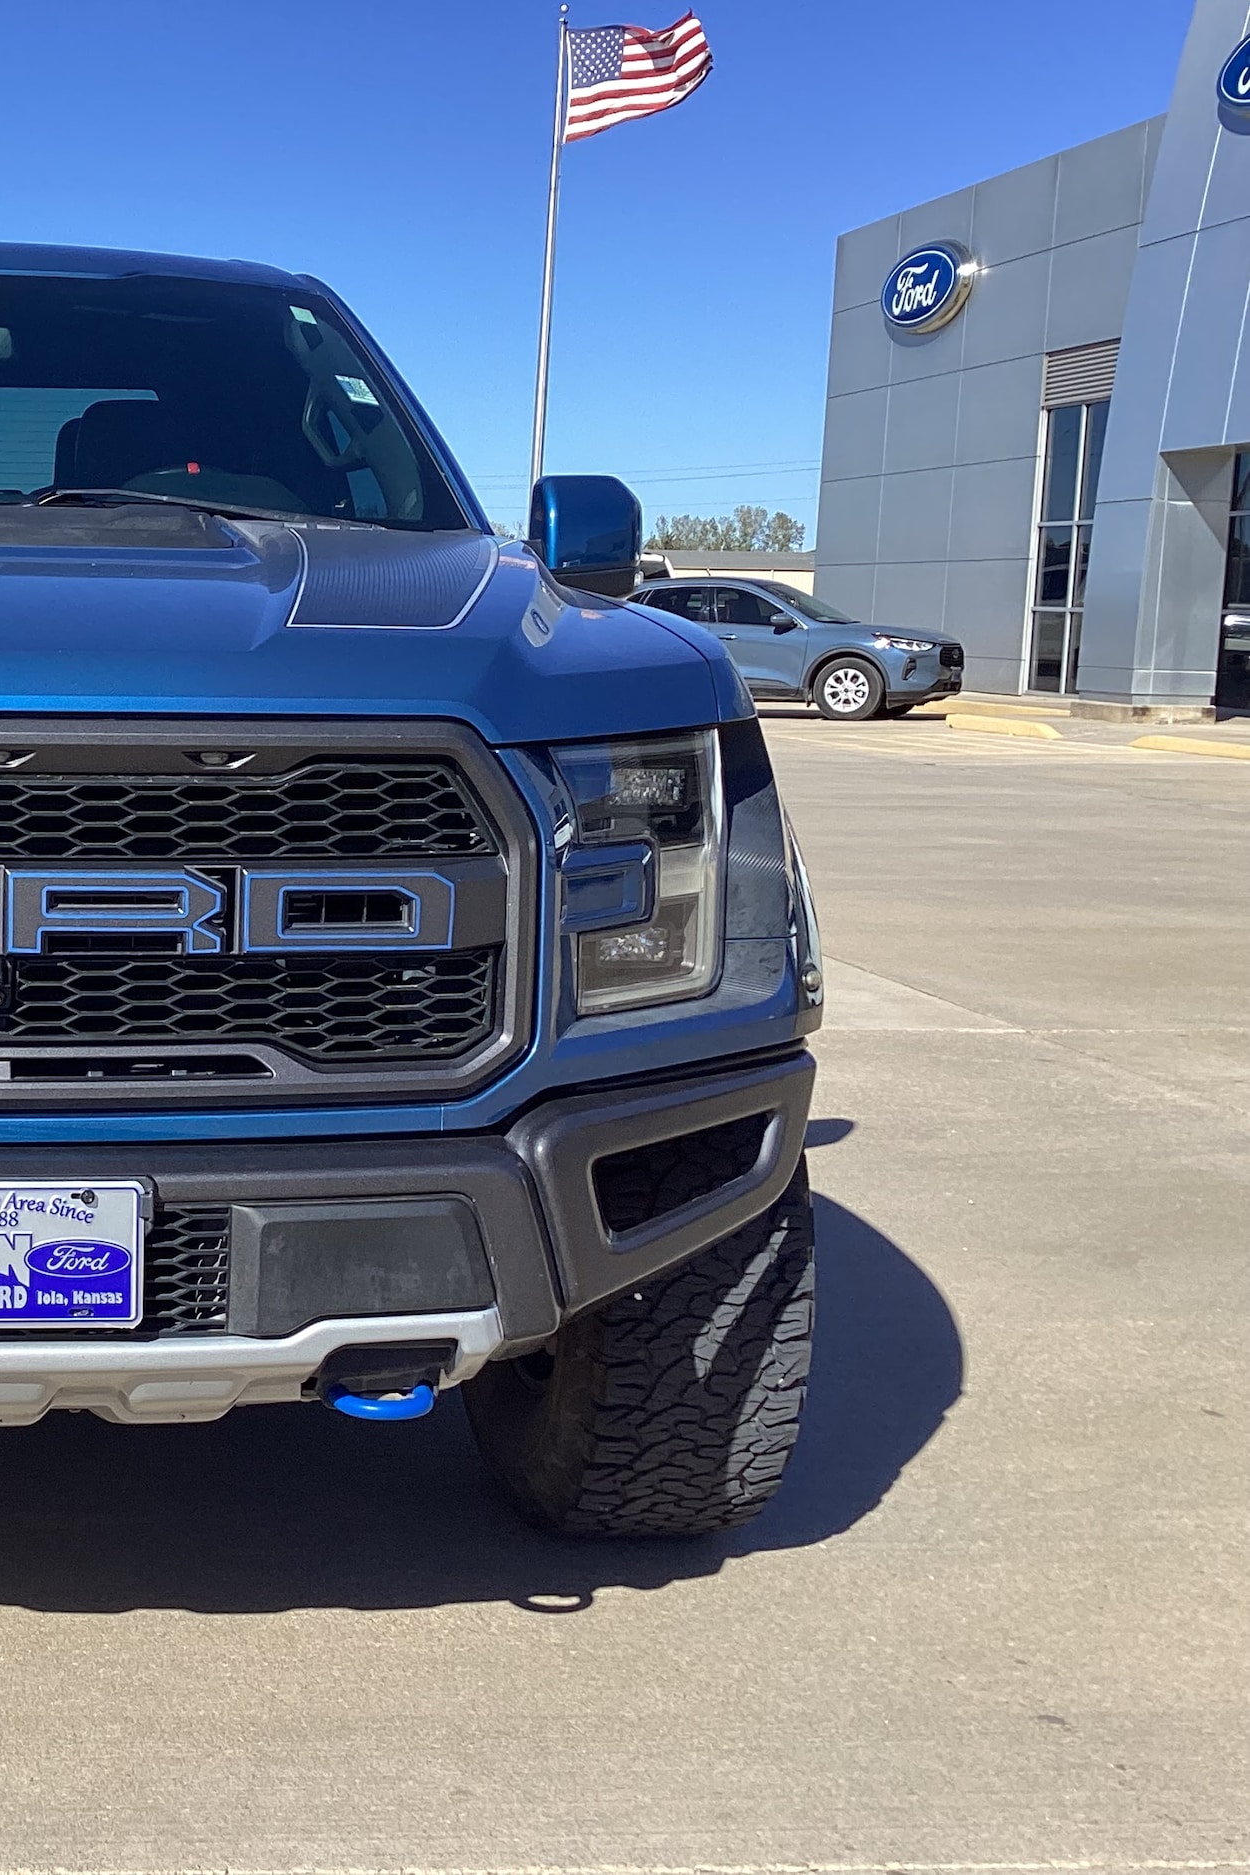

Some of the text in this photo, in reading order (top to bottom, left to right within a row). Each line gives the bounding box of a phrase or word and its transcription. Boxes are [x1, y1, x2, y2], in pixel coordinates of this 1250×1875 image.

[892, 262, 940, 316] Ford
[5, 1190, 46, 1213] Area
[49, 1198, 94, 1224] Since
[46, 1244, 110, 1271] Ford
[37, 1290, 124, 1307] Iola, Kansas
